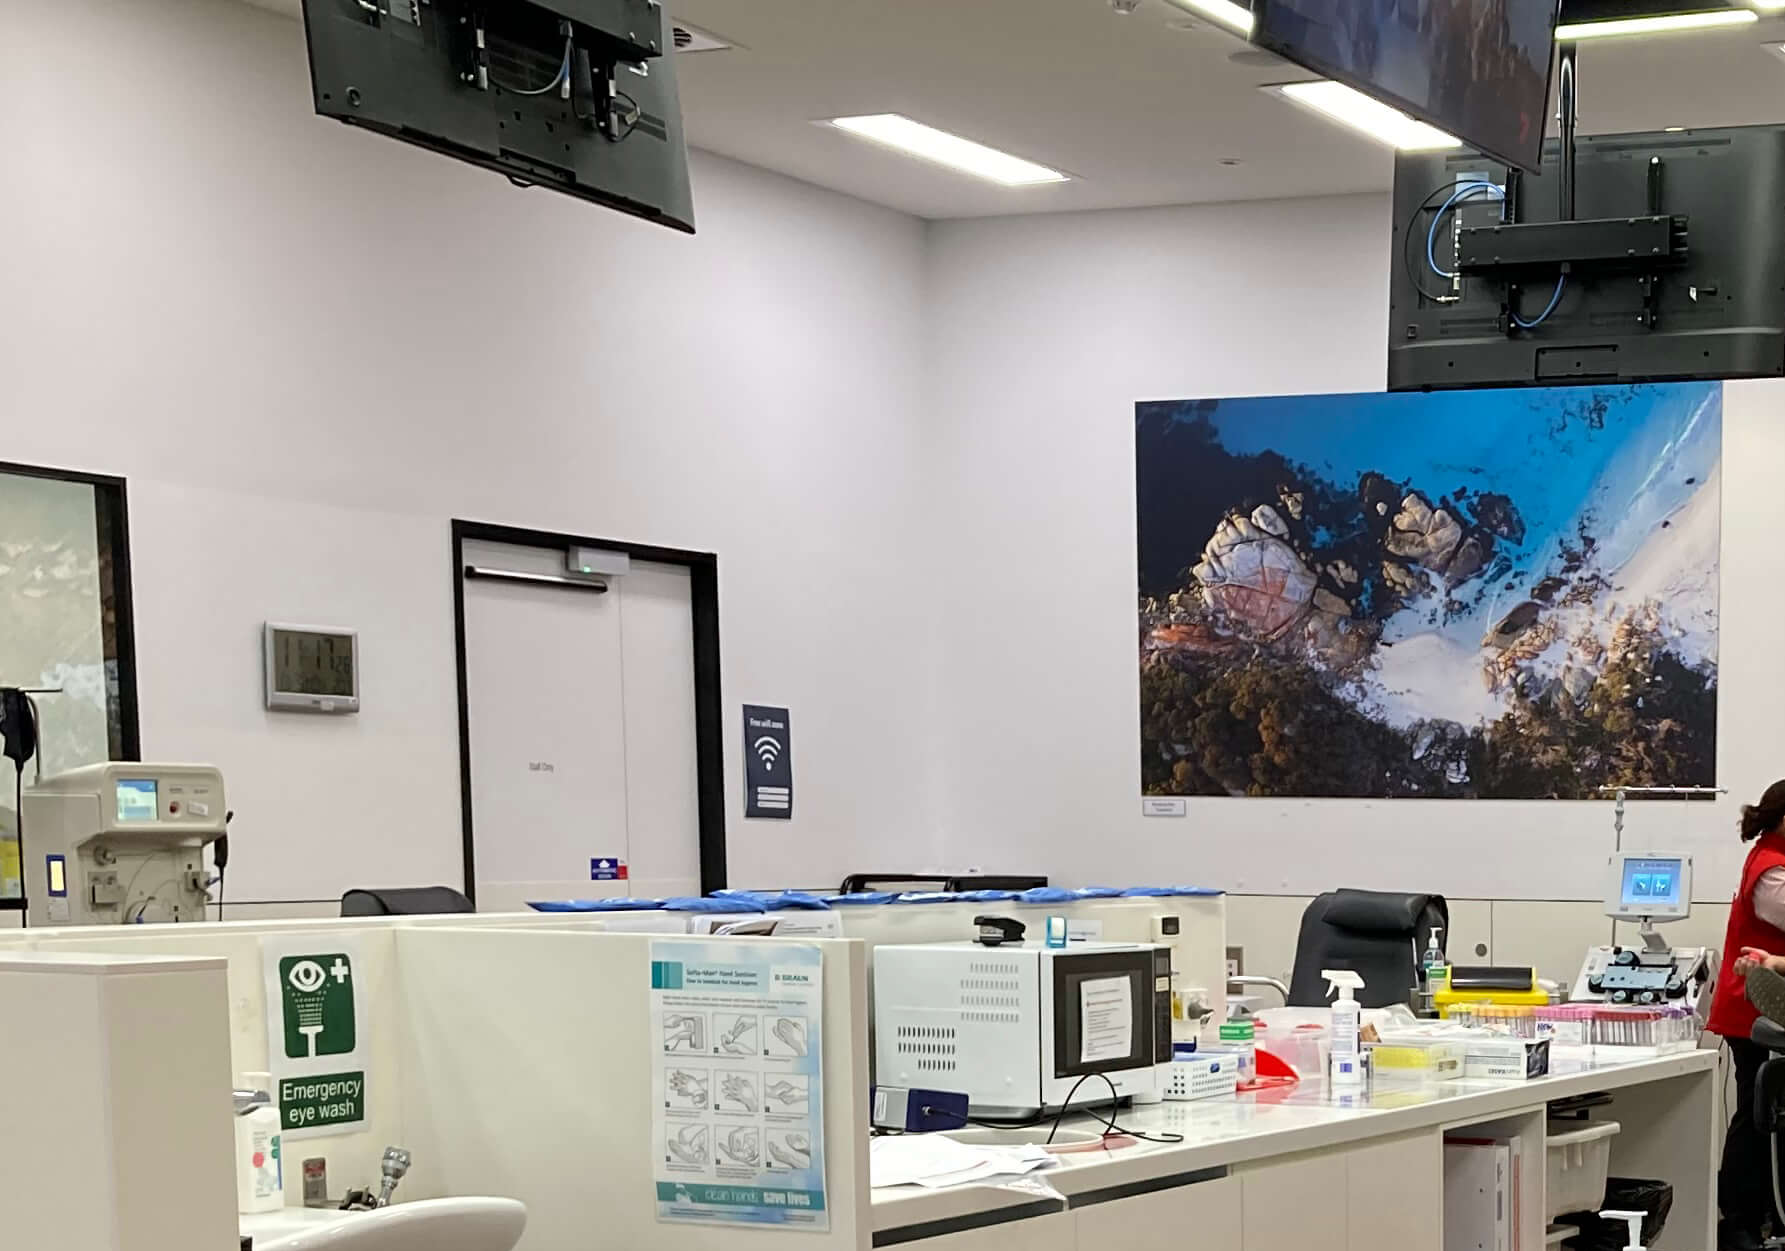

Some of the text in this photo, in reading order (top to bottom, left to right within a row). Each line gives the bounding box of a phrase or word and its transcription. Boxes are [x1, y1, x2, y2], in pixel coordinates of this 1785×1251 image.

[283, 1079, 361, 1101] Emergency
[289, 1099, 354, 1125] eye wash
